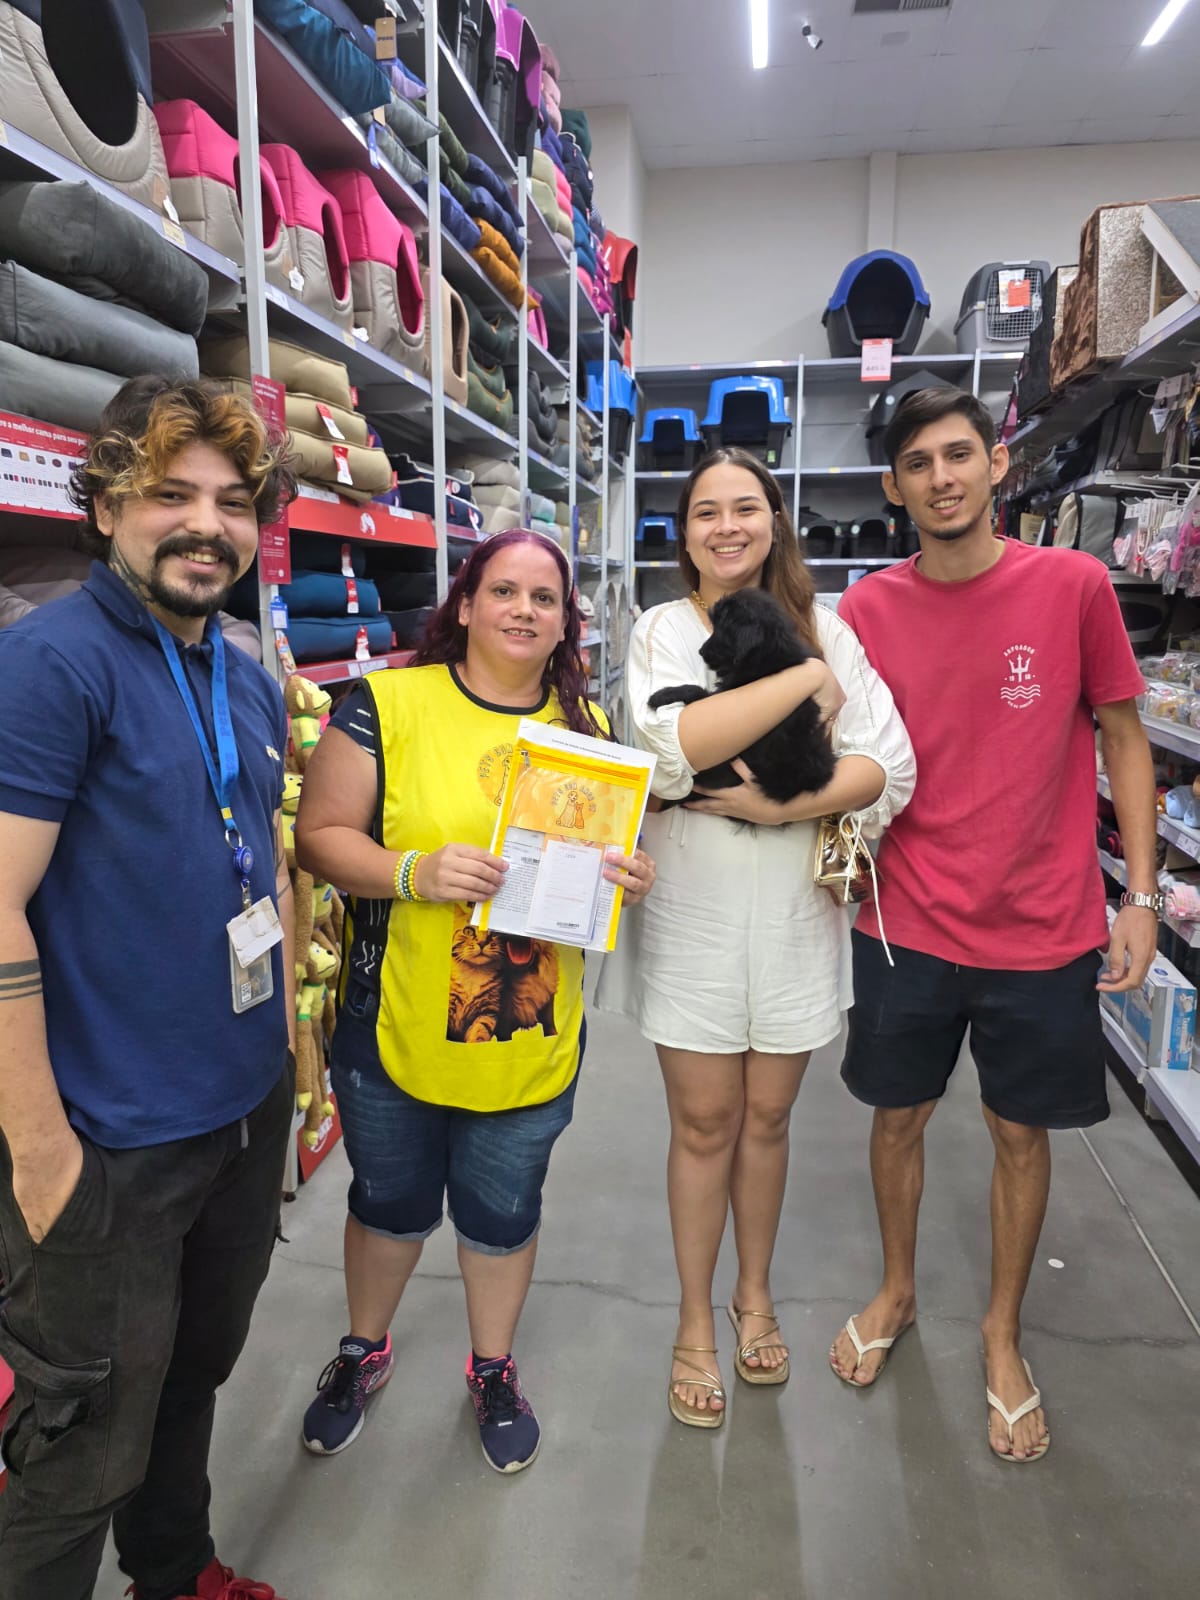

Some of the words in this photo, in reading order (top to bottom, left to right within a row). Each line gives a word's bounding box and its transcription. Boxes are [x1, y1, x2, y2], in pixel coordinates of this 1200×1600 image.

[12, 422, 34, 433] melhor
[36, 429, 51, 438] cama
[53, 433, 67, 441] para
